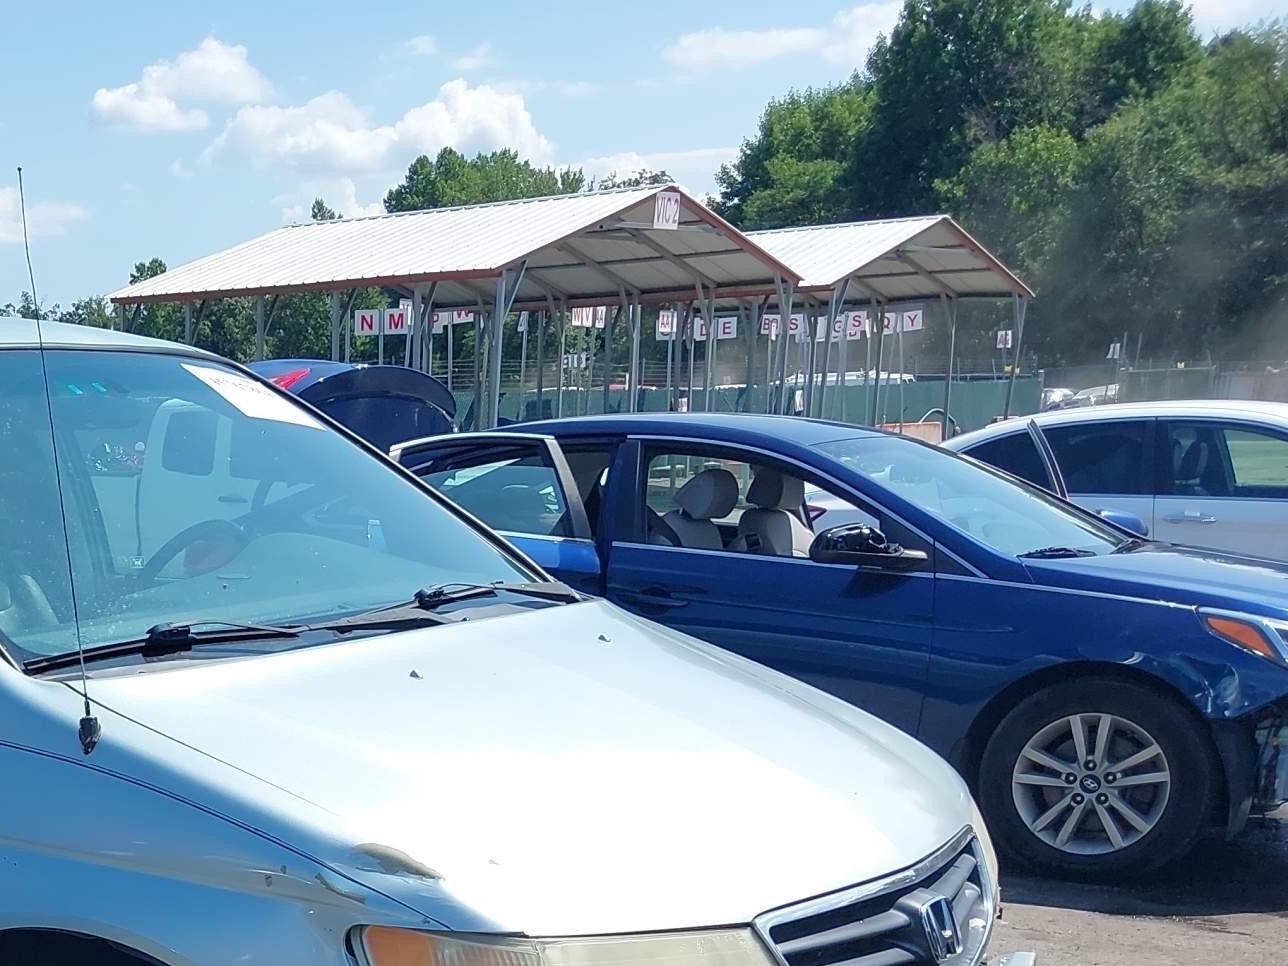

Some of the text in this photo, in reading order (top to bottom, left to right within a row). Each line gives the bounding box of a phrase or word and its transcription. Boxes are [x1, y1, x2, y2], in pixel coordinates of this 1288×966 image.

[657, 196, 679, 225] VIC 2
[360, 314, 374, 332] N
[389, 312, 404, 330] M
[660, 314, 670, 329] AA
[722, 321, 732, 335] E
[789, 318, 799, 331] S
[852, 315, 862, 328] S
[907, 313, 918, 328] Y
